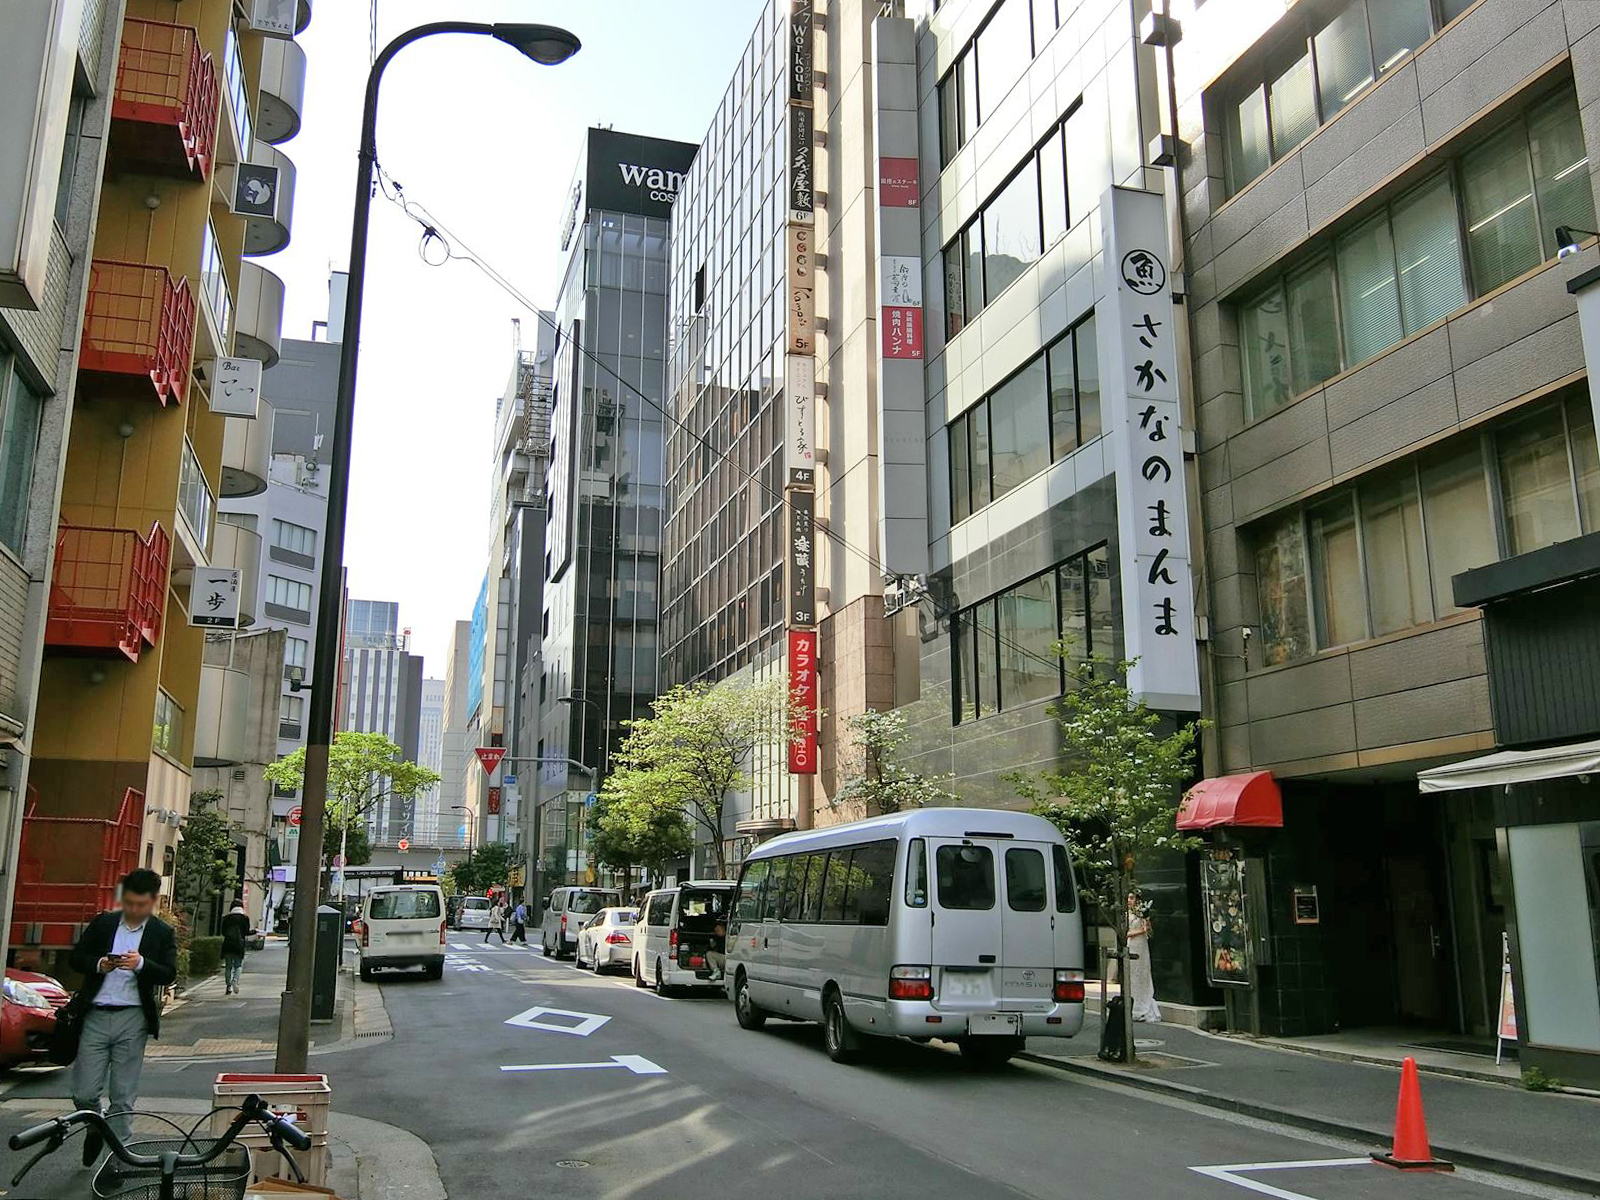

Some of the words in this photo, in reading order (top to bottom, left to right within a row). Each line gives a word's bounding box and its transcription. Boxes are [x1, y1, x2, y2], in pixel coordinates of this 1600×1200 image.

[792, 24, 807, 92] Workout
[792, 146, 812, 208] マタギ屋敷
[796, 211, 809, 220] 6F
[1126, 252, 1161, 289] 魚
[795, 338, 809, 349] 5F
[891, 310, 902, 355] 焼肉ハンナ
[222, 361, 240, 372] Bar
[795, 470, 810, 481] 4F
[1132, 313, 1178, 636] さかなのまんま
[206, 579, 229, 611] 一歩
[795, 611, 810, 622] 3F
[796, 639, 810, 696] カラオケ
